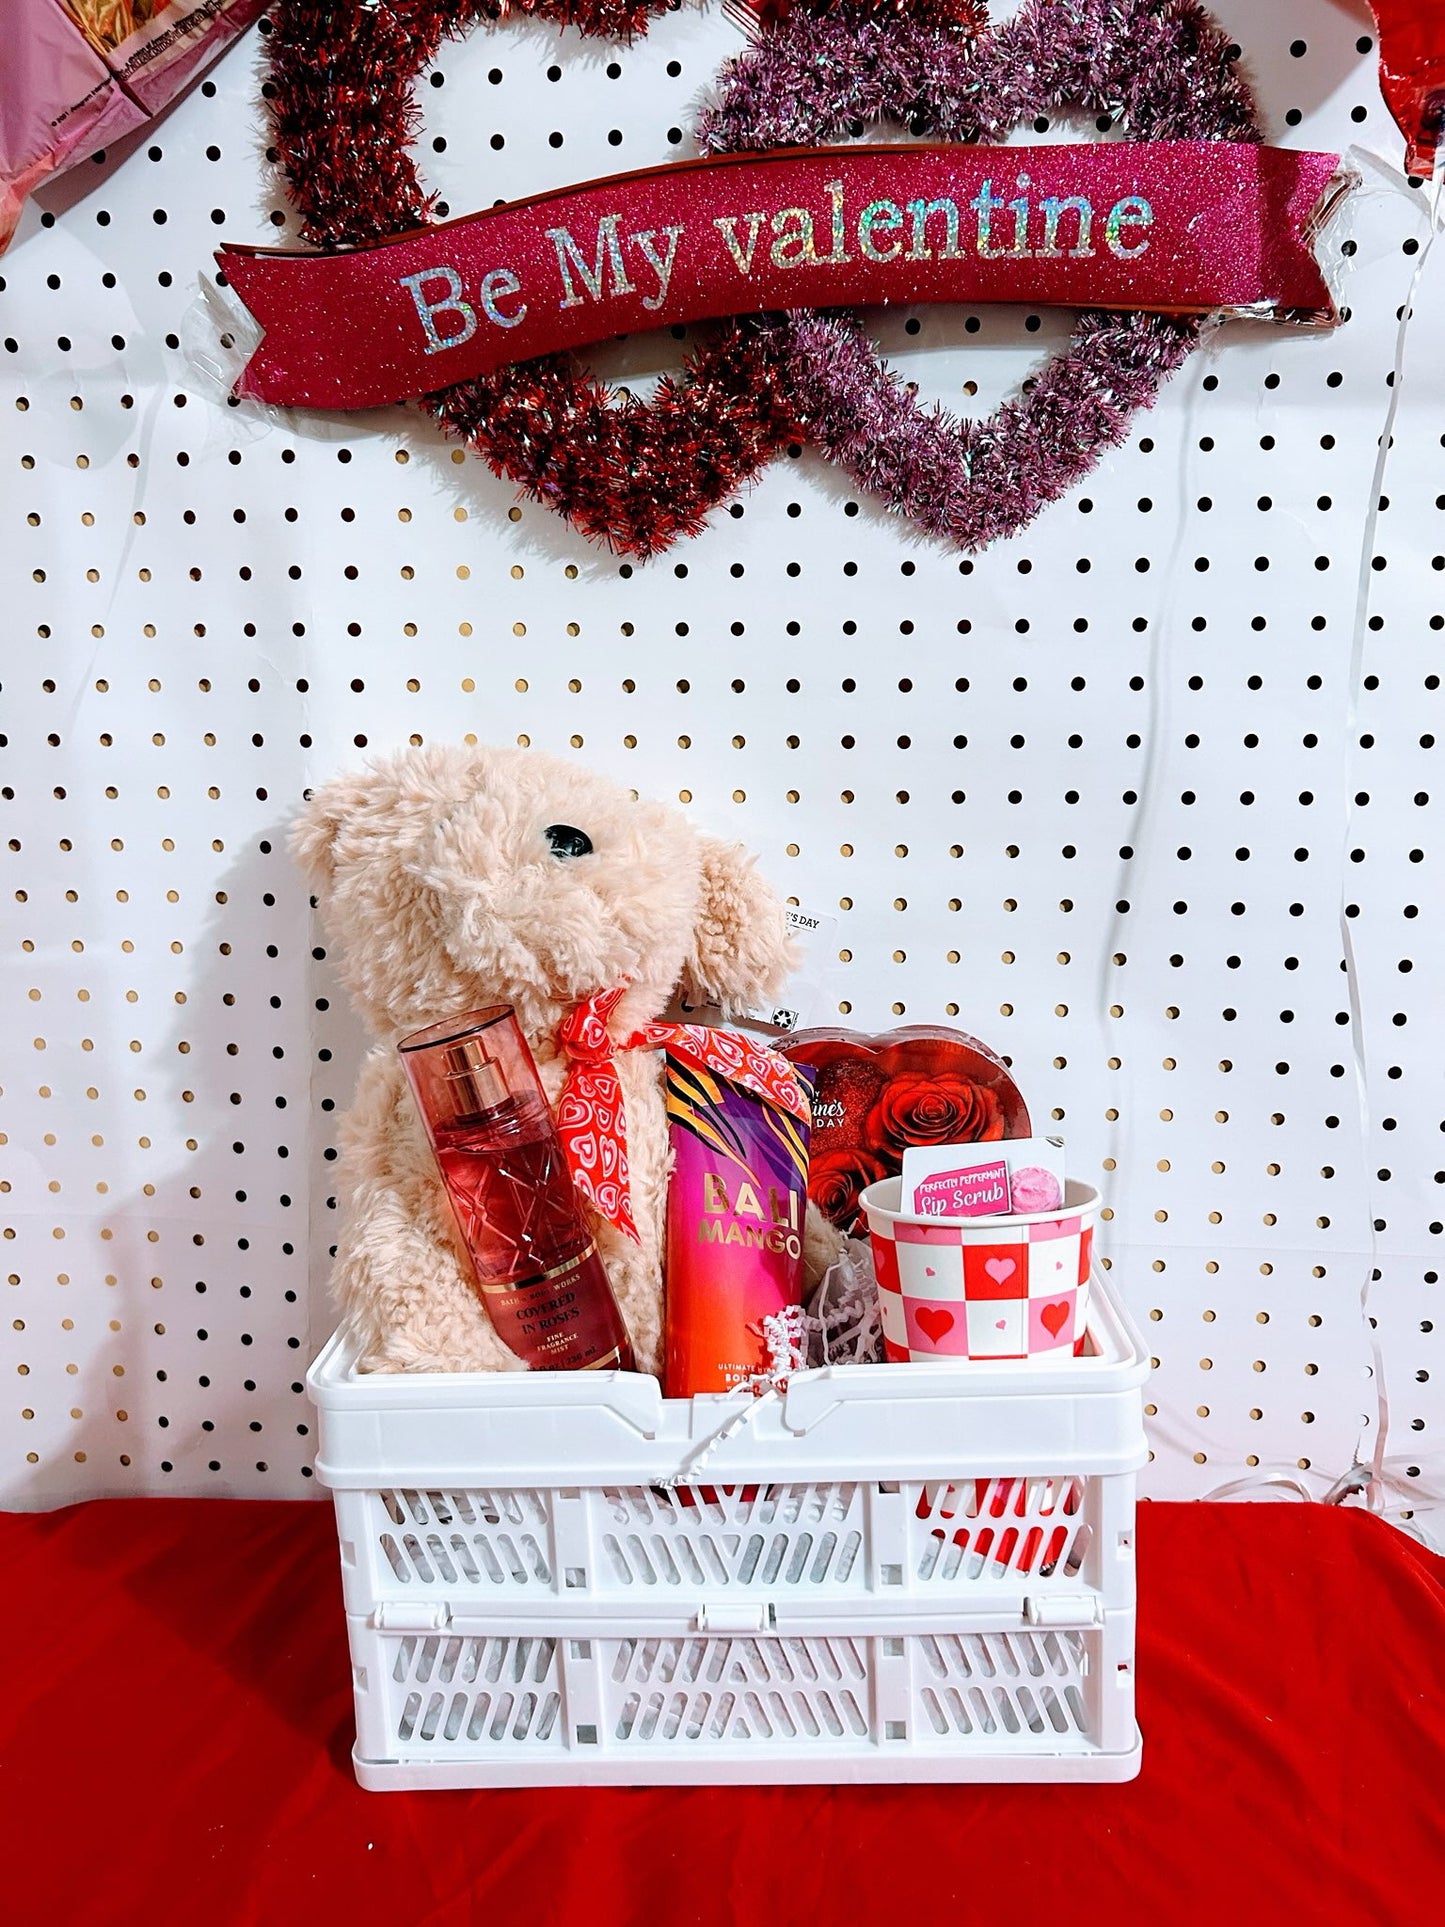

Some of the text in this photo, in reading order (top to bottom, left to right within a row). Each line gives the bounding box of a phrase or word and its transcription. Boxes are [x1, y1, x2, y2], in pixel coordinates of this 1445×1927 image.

[400, 172, 1153, 356] Be My valentine
[799, 915, 820, 929] DAY
[816, 1118, 844, 1128] DAY
[919, 1167, 1006, 1195] PERFECTLY PEPPERMINT
[703, 1172, 799, 1231] BALI
[919, 1182, 1004, 1216] Lip Scrub
[697, 1219, 801, 1260] MANGO
[553, 1273, 581, 1290] WORKS
[516, 1291, 576, 1320] COVERED
[522, 1306, 580, 1335] IN ROSES
[537, 1332, 579, 1351] FRAGRANCE
[546, 1331, 564, 1342] FINE
[550, 1343, 569, 1354] MIST
[717, 1363, 755, 1372] ULTIMATE
[725, 1373, 749, 1383] BOD
